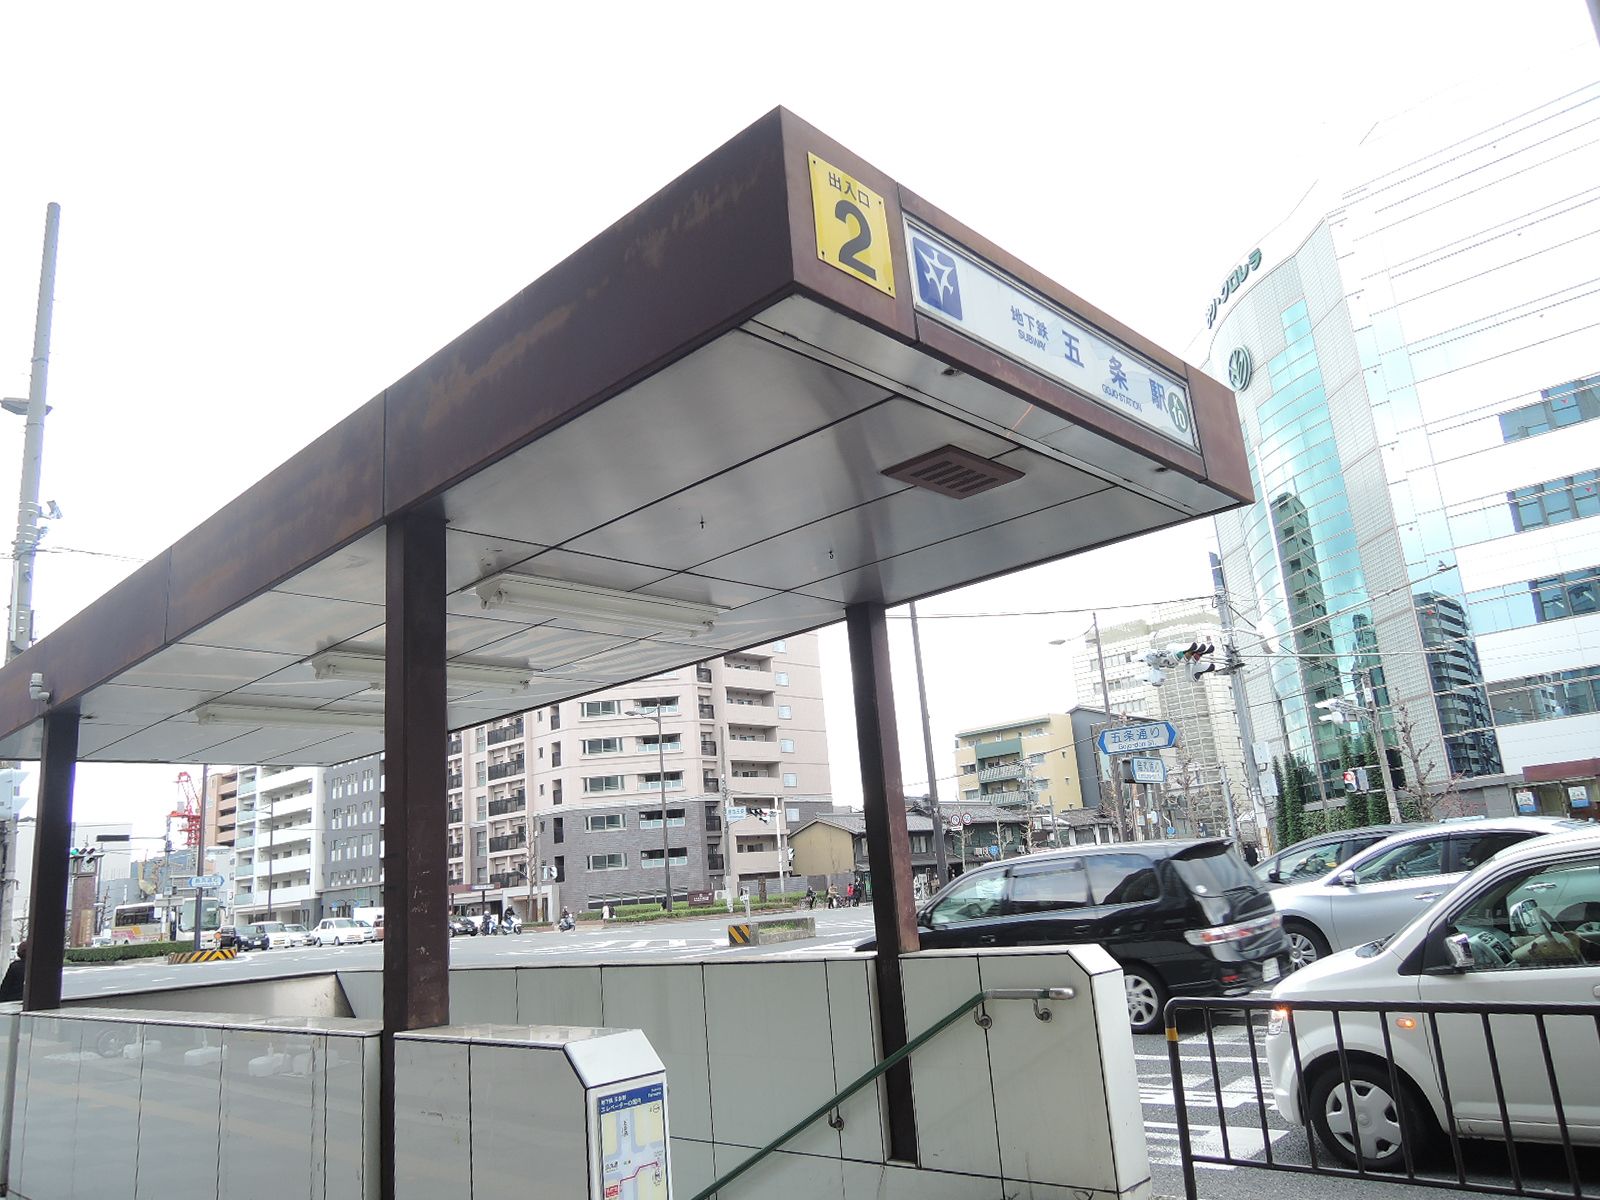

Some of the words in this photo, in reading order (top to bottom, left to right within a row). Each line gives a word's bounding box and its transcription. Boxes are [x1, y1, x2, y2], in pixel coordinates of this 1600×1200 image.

[828, 171, 870, 208] 出入口
[834, 199, 877, 281] 2
[1017, 328, 1047, 352] SUBWAY
[1010, 305, 1049, 342] 地下鉄
[1061, 329, 1169, 414] 五条駅
[1101, 383, 1121, 401] GOJO
[1118, 392, 1143, 413] STATION
[1171, 407, 1187, 430] 10
[1111, 727, 1160, 743] 五条通り
